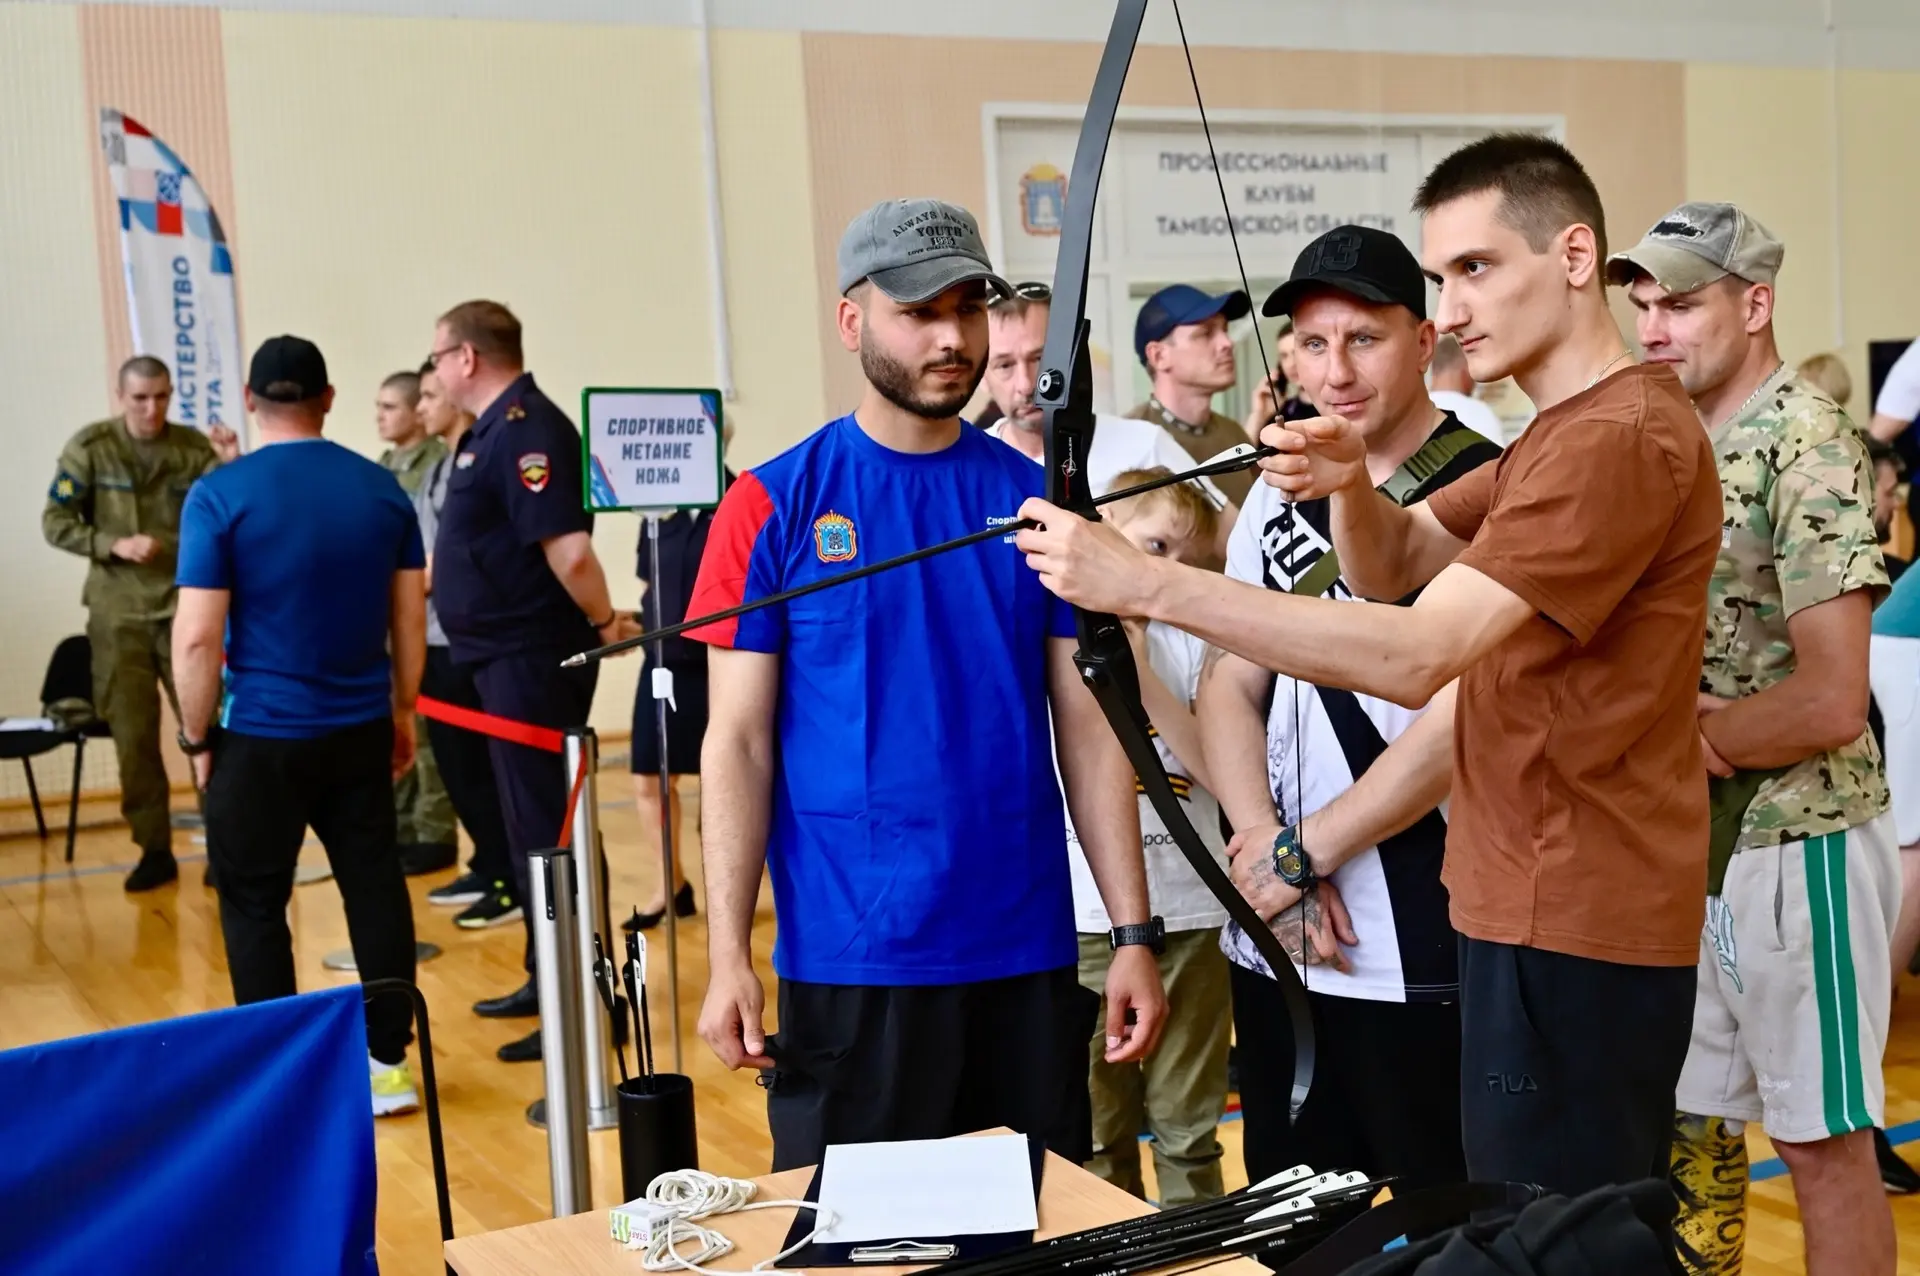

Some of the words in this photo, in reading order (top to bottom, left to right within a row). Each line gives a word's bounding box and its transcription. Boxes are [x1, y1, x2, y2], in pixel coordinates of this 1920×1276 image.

[1158, 152, 1389, 173] ПРОФЕССИОНАЛЬНЫЕ
[1244, 184, 1315, 204] КЛУБЫ
[892, 210, 937, 238] ALWAYS
[915, 225, 963, 238] YOUTH
[1156, 212, 1298, 236] ТАМБОВСКОЙ
[1308, 231, 1363, 276] 13
[172, 255, 198, 422] ИСТЕРСТВО
[206, 379, 223, 426] РТА
[607, 418, 706, 436] СПОРТИВНОЕ
[621, 442, 693, 461] МЕТАНИЕ
[635, 467, 681, 485] НОЖА
[1486, 1072, 1538, 1095] FILA
